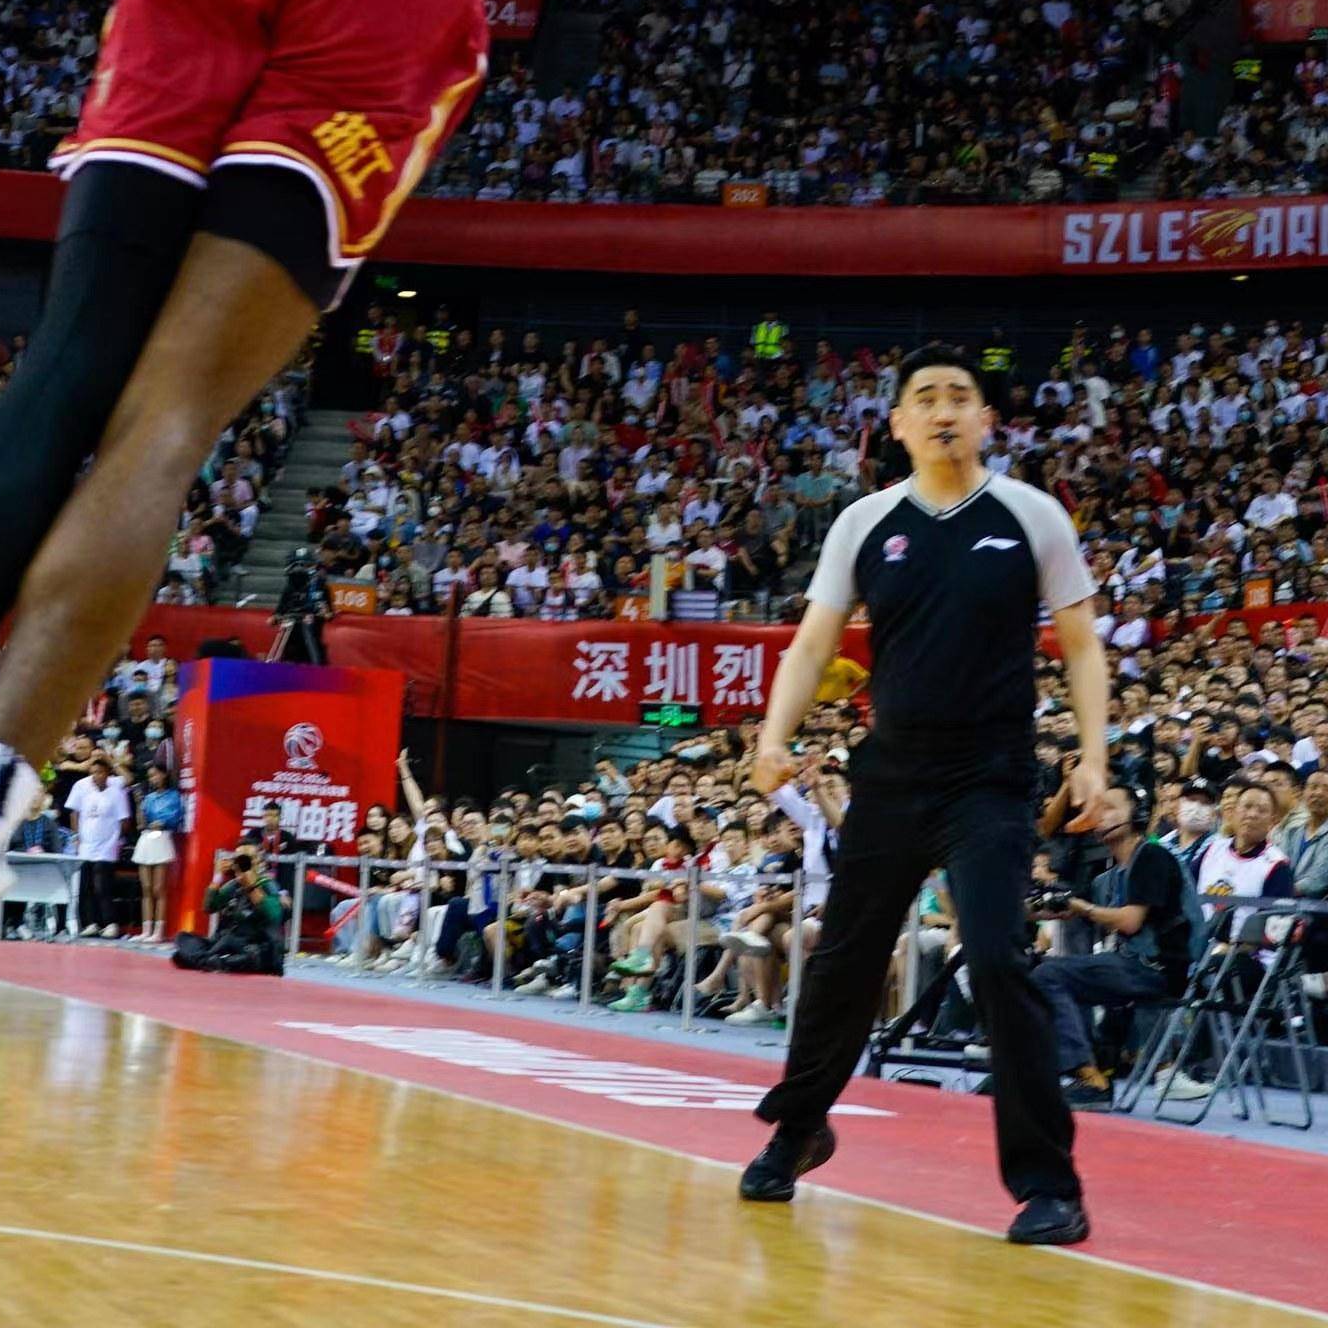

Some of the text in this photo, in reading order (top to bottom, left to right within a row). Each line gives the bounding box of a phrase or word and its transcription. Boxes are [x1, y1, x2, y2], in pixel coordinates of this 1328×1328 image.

[311, 111, 394, 200] 浙江
[572, 638, 787, 706] 深圳烈
